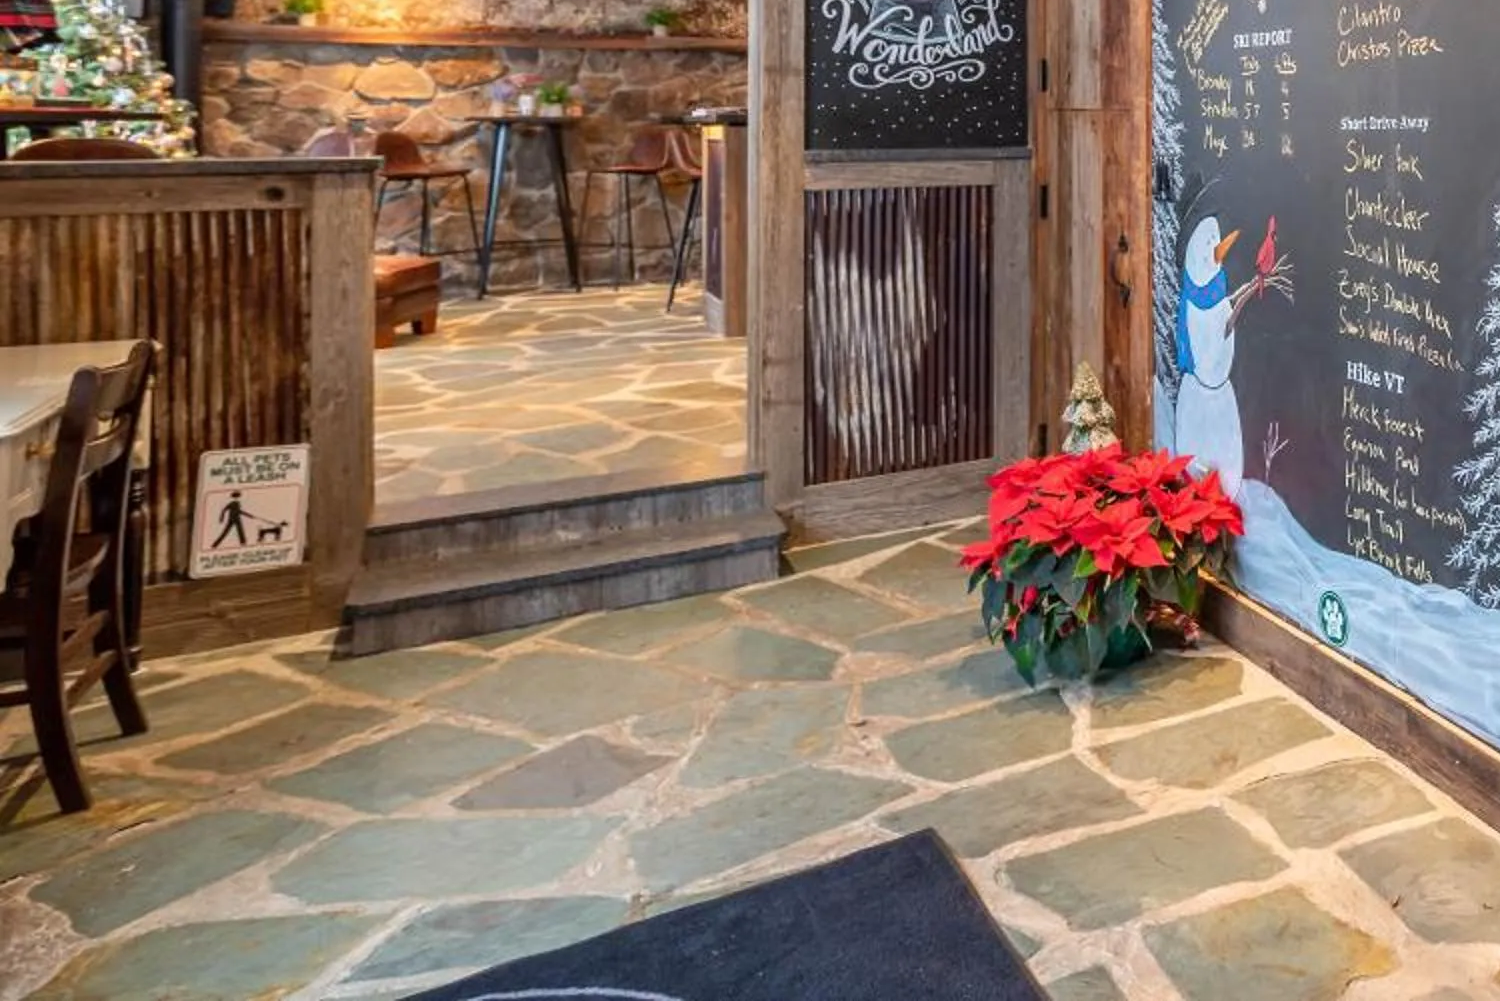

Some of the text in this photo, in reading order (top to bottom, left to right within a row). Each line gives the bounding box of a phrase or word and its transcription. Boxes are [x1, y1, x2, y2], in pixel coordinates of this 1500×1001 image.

[1337, 1, 1401, 36] Cilantro
[1233, 27, 1293, 49] SKI REPORT
[1399, 115, 1429, 133] Away
[1396, 243, 1441, 284] House
[1346, 360, 1405, 394] Hike VT
[253, 453, 291, 463] PETS
[279, 461, 301, 471] ON
[223, 472, 287, 484] A LEASH
